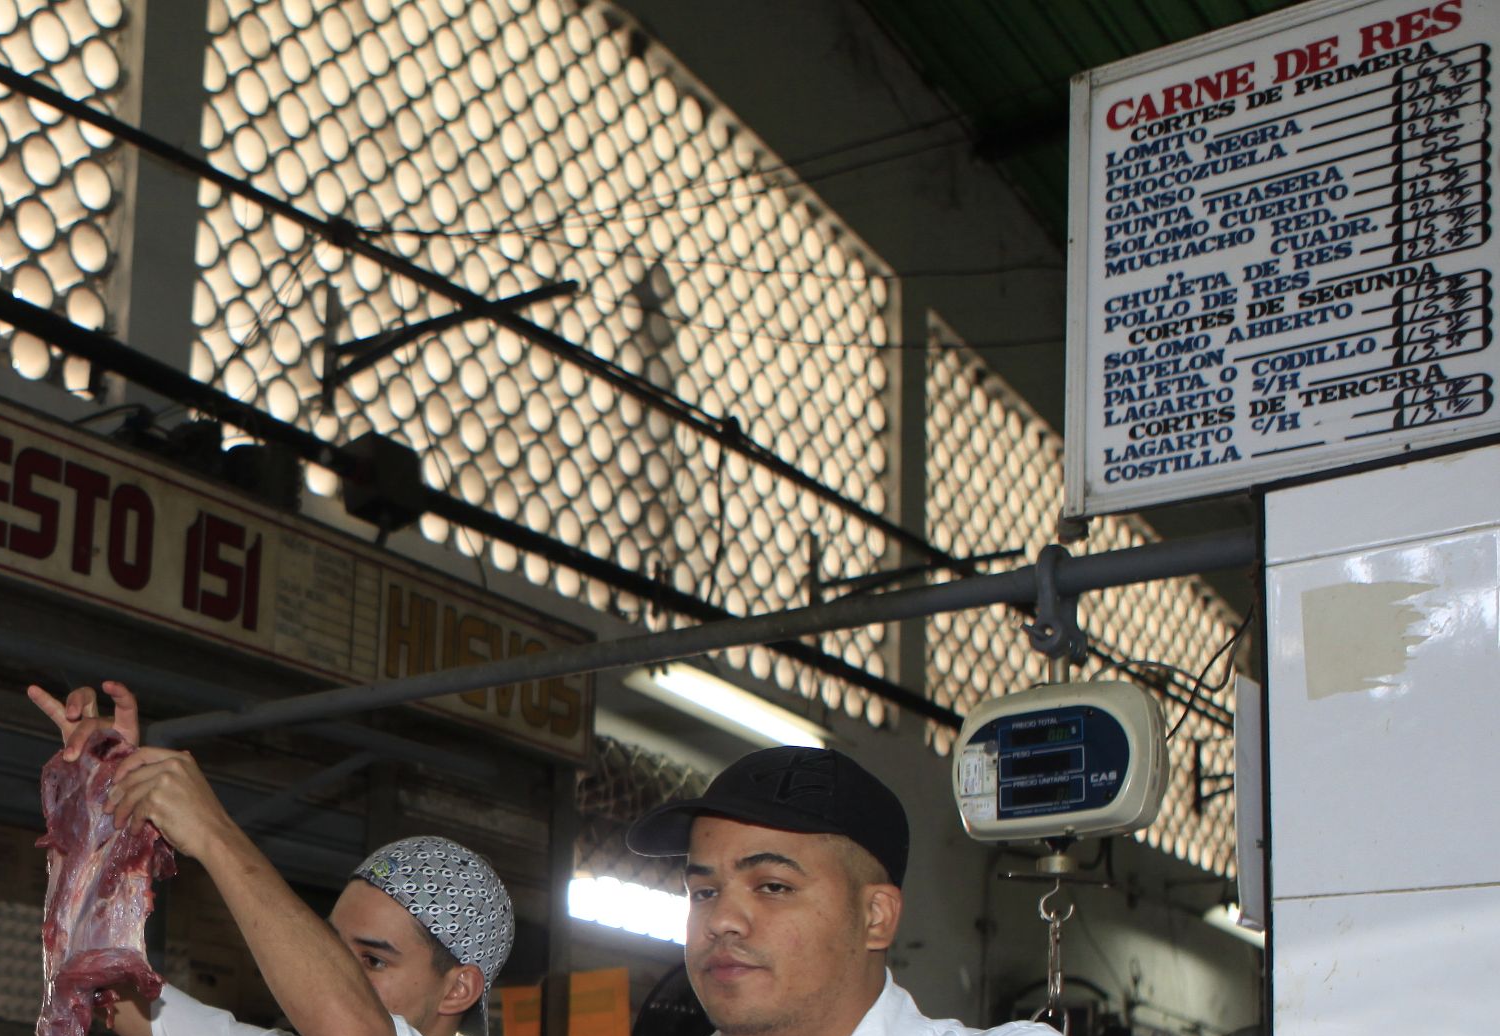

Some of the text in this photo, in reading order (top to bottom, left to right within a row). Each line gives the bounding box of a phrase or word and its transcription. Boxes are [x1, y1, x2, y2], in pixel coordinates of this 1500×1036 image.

[1106, 0, 1463, 131] CARNE DE RES
[1131, 42, 1438, 141] CORTES DE PRIMERA
[1105, 128, 1207, 169] LOMITO
[1105, 143, 1287, 203] CHOCOZUELA
[1106, 150, 1192, 187] PULPA
[1204, 119, 1302, 160] NEGRA
[1104, 221, 1209, 259] SOLOMO
[1220, 185, 1348, 229] CUERITO
[1105, 206, 1193, 241] PUNTA
[1202, 165, 1344, 216] TRASERA
[1105, 187, 1195, 221] GANSO
[1270, 217, 1378, 254] CUADR.
[1104, 228, 1255, 278] MUCHACHO
[1270, 208, 1337, 237] RED.
[1104, 272, 1231, 314] CHULETA
[1243, 259, 1281, 282] DE
[1292, 242, 1353, 269] RES
[1104, 300, 1190, 333] POLLO
[1202, 288, 1238, 309] DE
[1252, 271, 1310, 299] RES
[1128, 262, 1441, 346] CORTES DE SEGUNDA
[1103, 334, 1211, 370] SOLOMO
[1225, 302, 1353, 345] ABIERTO
[1104, 349, 1225, 388] PAPELON
[1103, 372, 1210, 407] PALETA
[1219, 367, 1238, 384] O
[1251, 337, 1376, 376] CODILLO
[1128, 364, 1448, 440] CORTES DE TERCERA
[1103, 387, 1234, 427] LAGARTO
[1104, 426, 1234, 466] LAGARTO
[1104, 446, 1242, 484] COSTILLA
[181, 509, 262, 633] 151
[1038, 717, 1058, 727] TOTAL
[1039, 775, 1070, 786] UNITARIO
